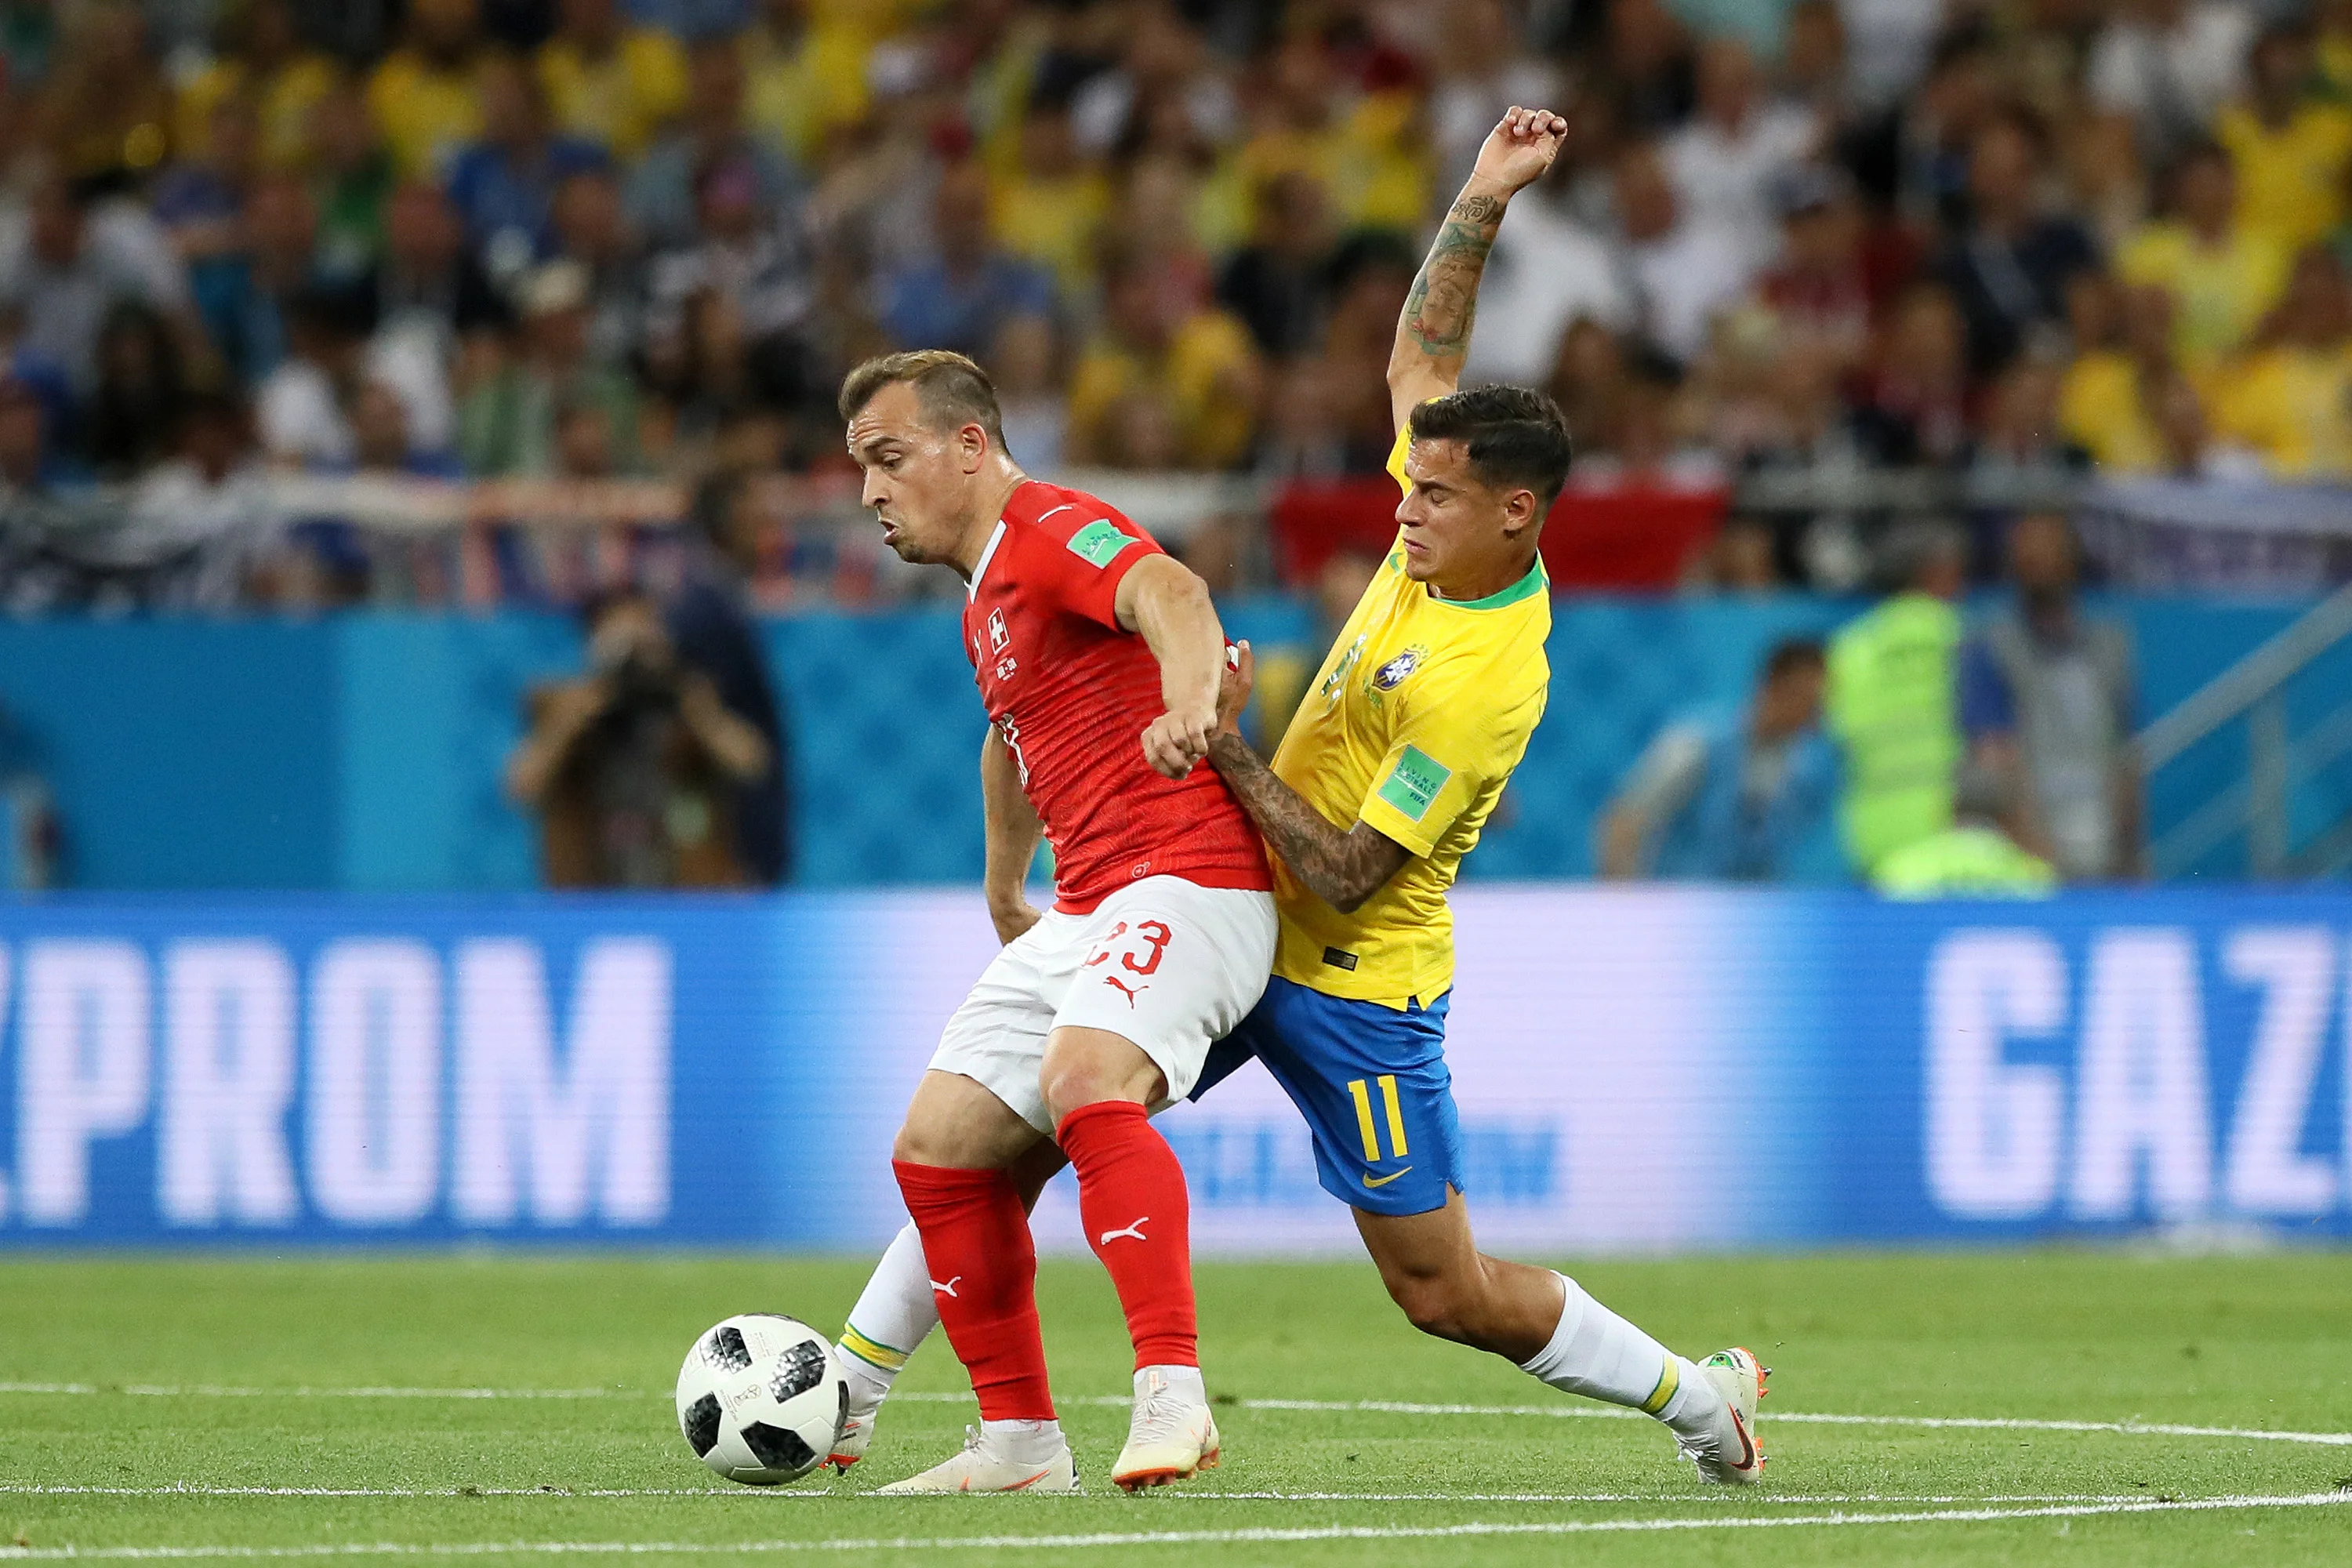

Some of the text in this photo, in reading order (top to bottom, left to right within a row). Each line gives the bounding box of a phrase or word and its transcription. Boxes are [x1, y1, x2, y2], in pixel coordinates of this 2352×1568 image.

[1409, 792, 1425, 806] FIFA
[0, 935, 673, 1227] PROM
[1348, 1075, 1408, 1162] 11
[1926, 927, 2352, 1221] GAZ
